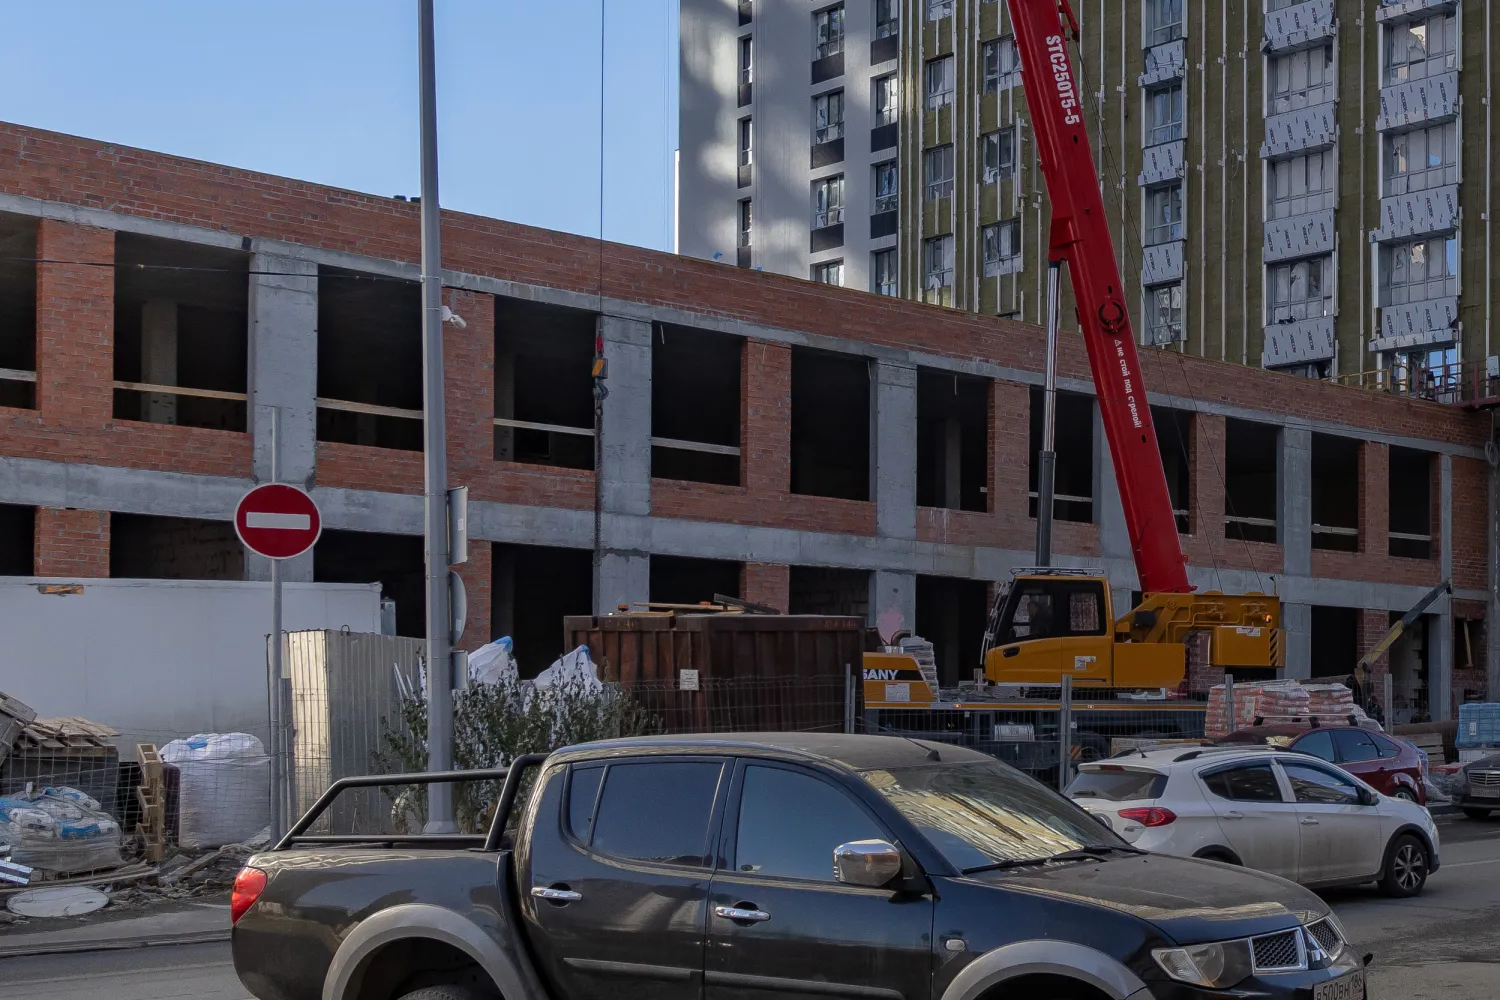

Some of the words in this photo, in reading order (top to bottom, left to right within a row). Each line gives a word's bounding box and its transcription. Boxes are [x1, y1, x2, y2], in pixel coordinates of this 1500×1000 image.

[1045, 34, 1080, 125] STC250T5-5
[1116, 347, 1124, 357] не
[1119, 359, 1130, 376] стой
[1124, 379, 1133, 394] под
[1128, 396, 1142, 428] стрелой!
